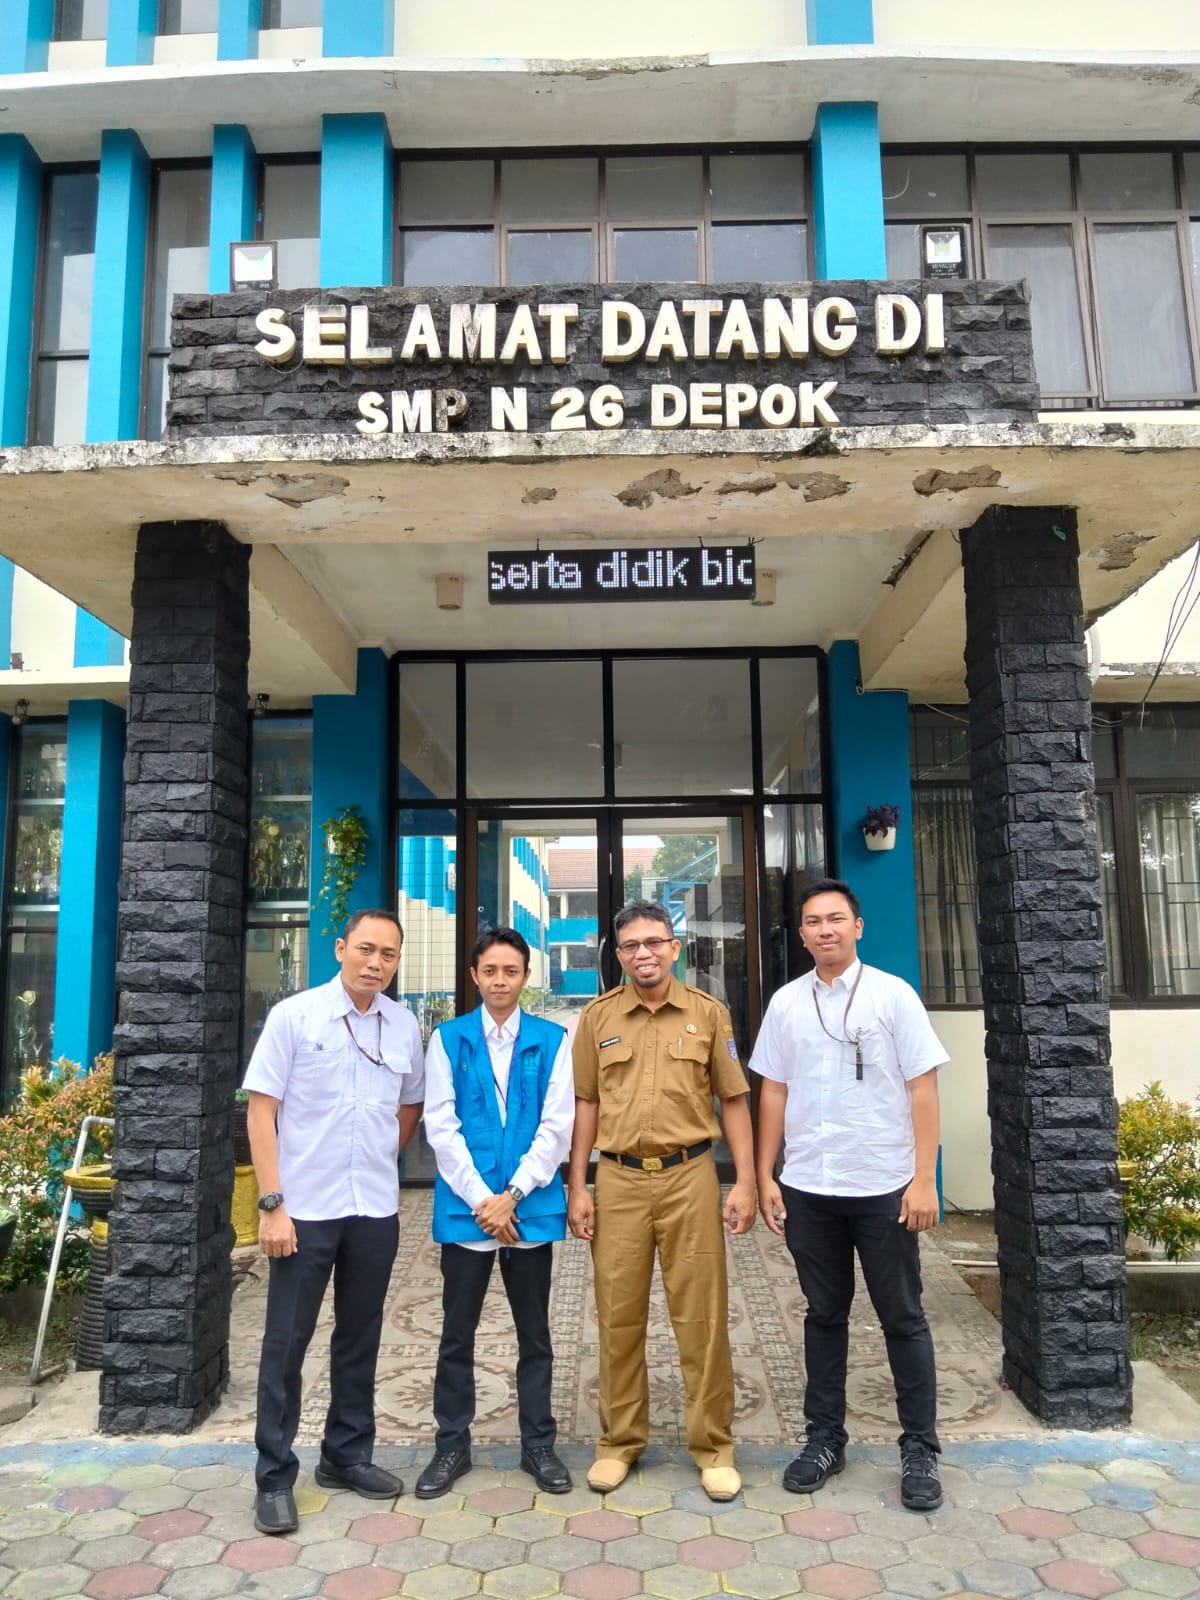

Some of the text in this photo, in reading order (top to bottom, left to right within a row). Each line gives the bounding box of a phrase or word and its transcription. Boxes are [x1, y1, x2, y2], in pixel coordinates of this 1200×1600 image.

[254, 293, 945, 365] SELAMAT DATANG DI
[355, 381, 841, 433] SMP N 26 DEPOK
[491, 552, 582, 590] serta
[596, 550, 690, 588] didik
